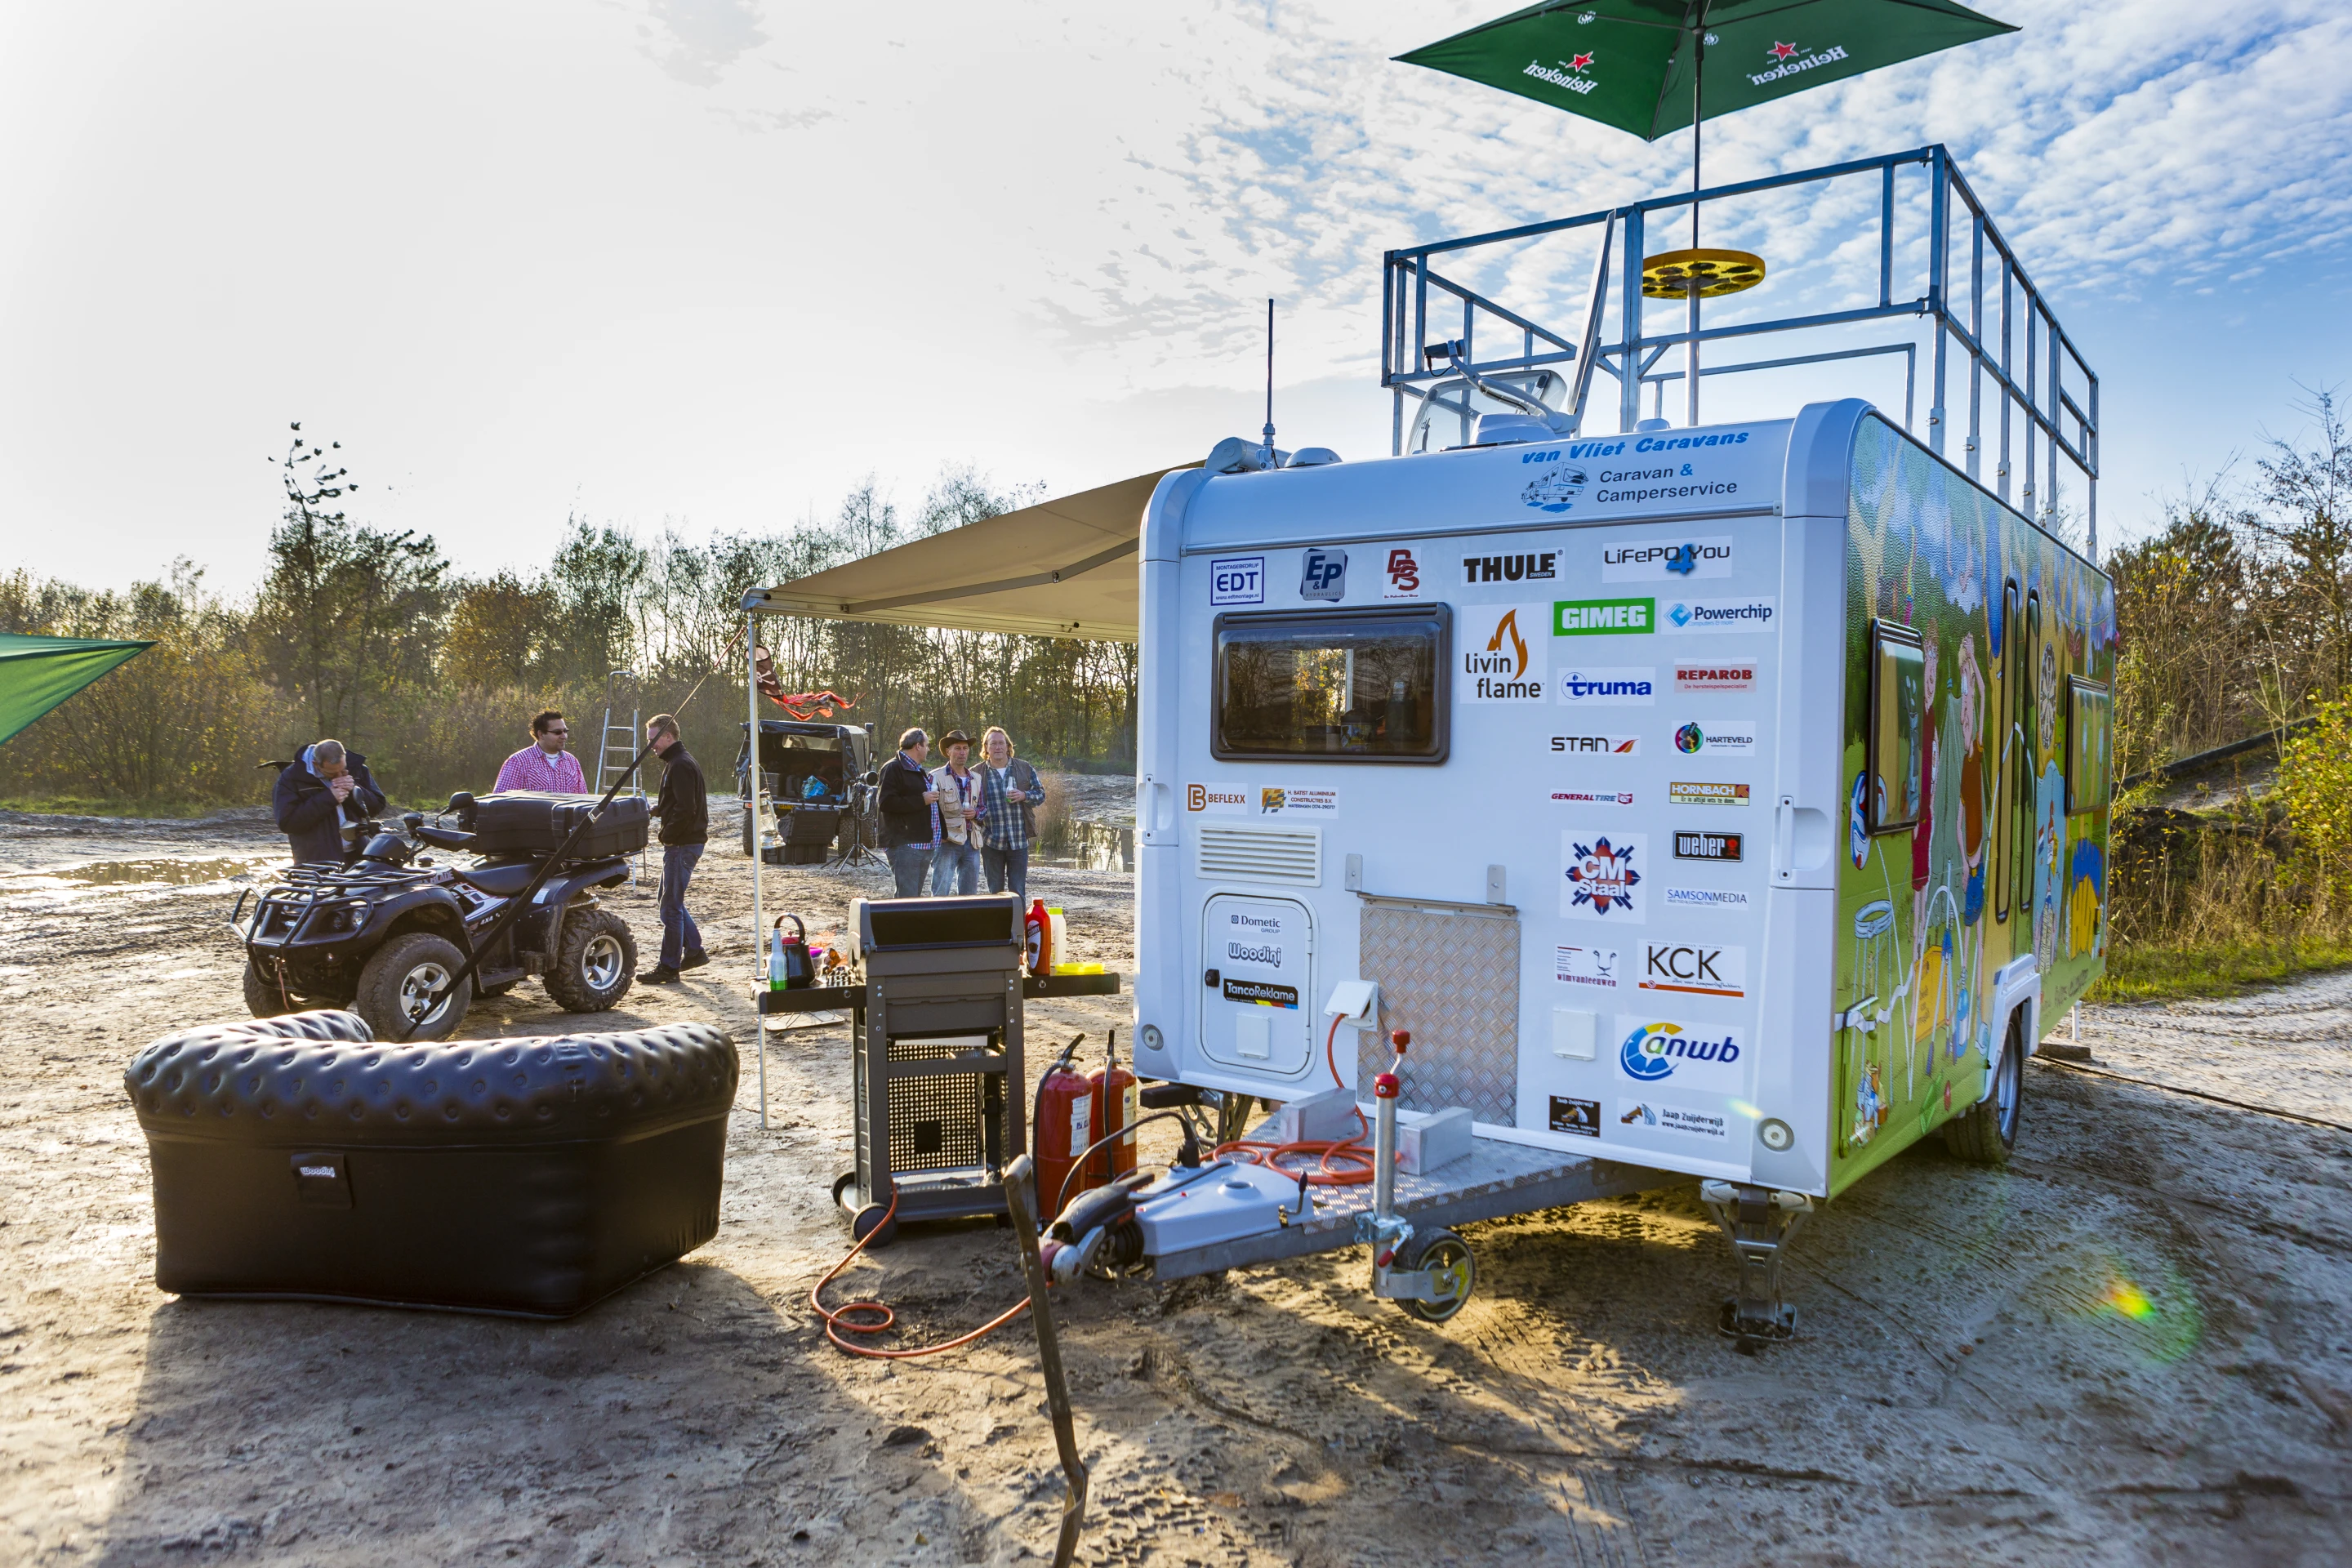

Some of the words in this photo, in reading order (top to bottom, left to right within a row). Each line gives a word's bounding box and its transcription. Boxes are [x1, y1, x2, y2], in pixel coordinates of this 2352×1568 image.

[1522, 450, 1561, 464] van
[1569, 441, 1625, 460] Vliet
[1635, 431, 1749, 453] Caravans
[1600, 466, 1673, 483] Caravan
[1679, 463, 1693, 476] &
[1597, 482, 1738, 503] Camperservice
[1463, 553, 1556, 583] THULE
[1216, 572, 1259, 592] EDT
[1561, 605, 1646, 629] GIMEG
[1695, 604, 1773, 622] Powerchip
[1465, 653, 1511, 674] livin
[1677, 669, 1753, 680] REPAROB
[1477, 678, 1542, 699] flame
[1566, 680, 1652, 697] truma
[1551, 737, 1609, 752] STAN
[1705, 736, 1753, 744] HARTEVELD
[1208, 794, 1246, 804] BEFLEXX
[1671, 784, 1735, 796] HORNBACH
[1678, 833, 1726, 857] weber
[1579, 855, 1625, 881] CM
[1579, 878, 1625, 898] Staal
[1241, 915, 1281, 928] Dometic
[1228, 942, 1281, 968] Woodini
[1647, 945, 1722, 982] KCK
[1227, 982, 1295, 1001] TancoReklame
[1646, 1036, 1740, 1062] anwb
[1662, 1108, 1680, 1120] Jaap
